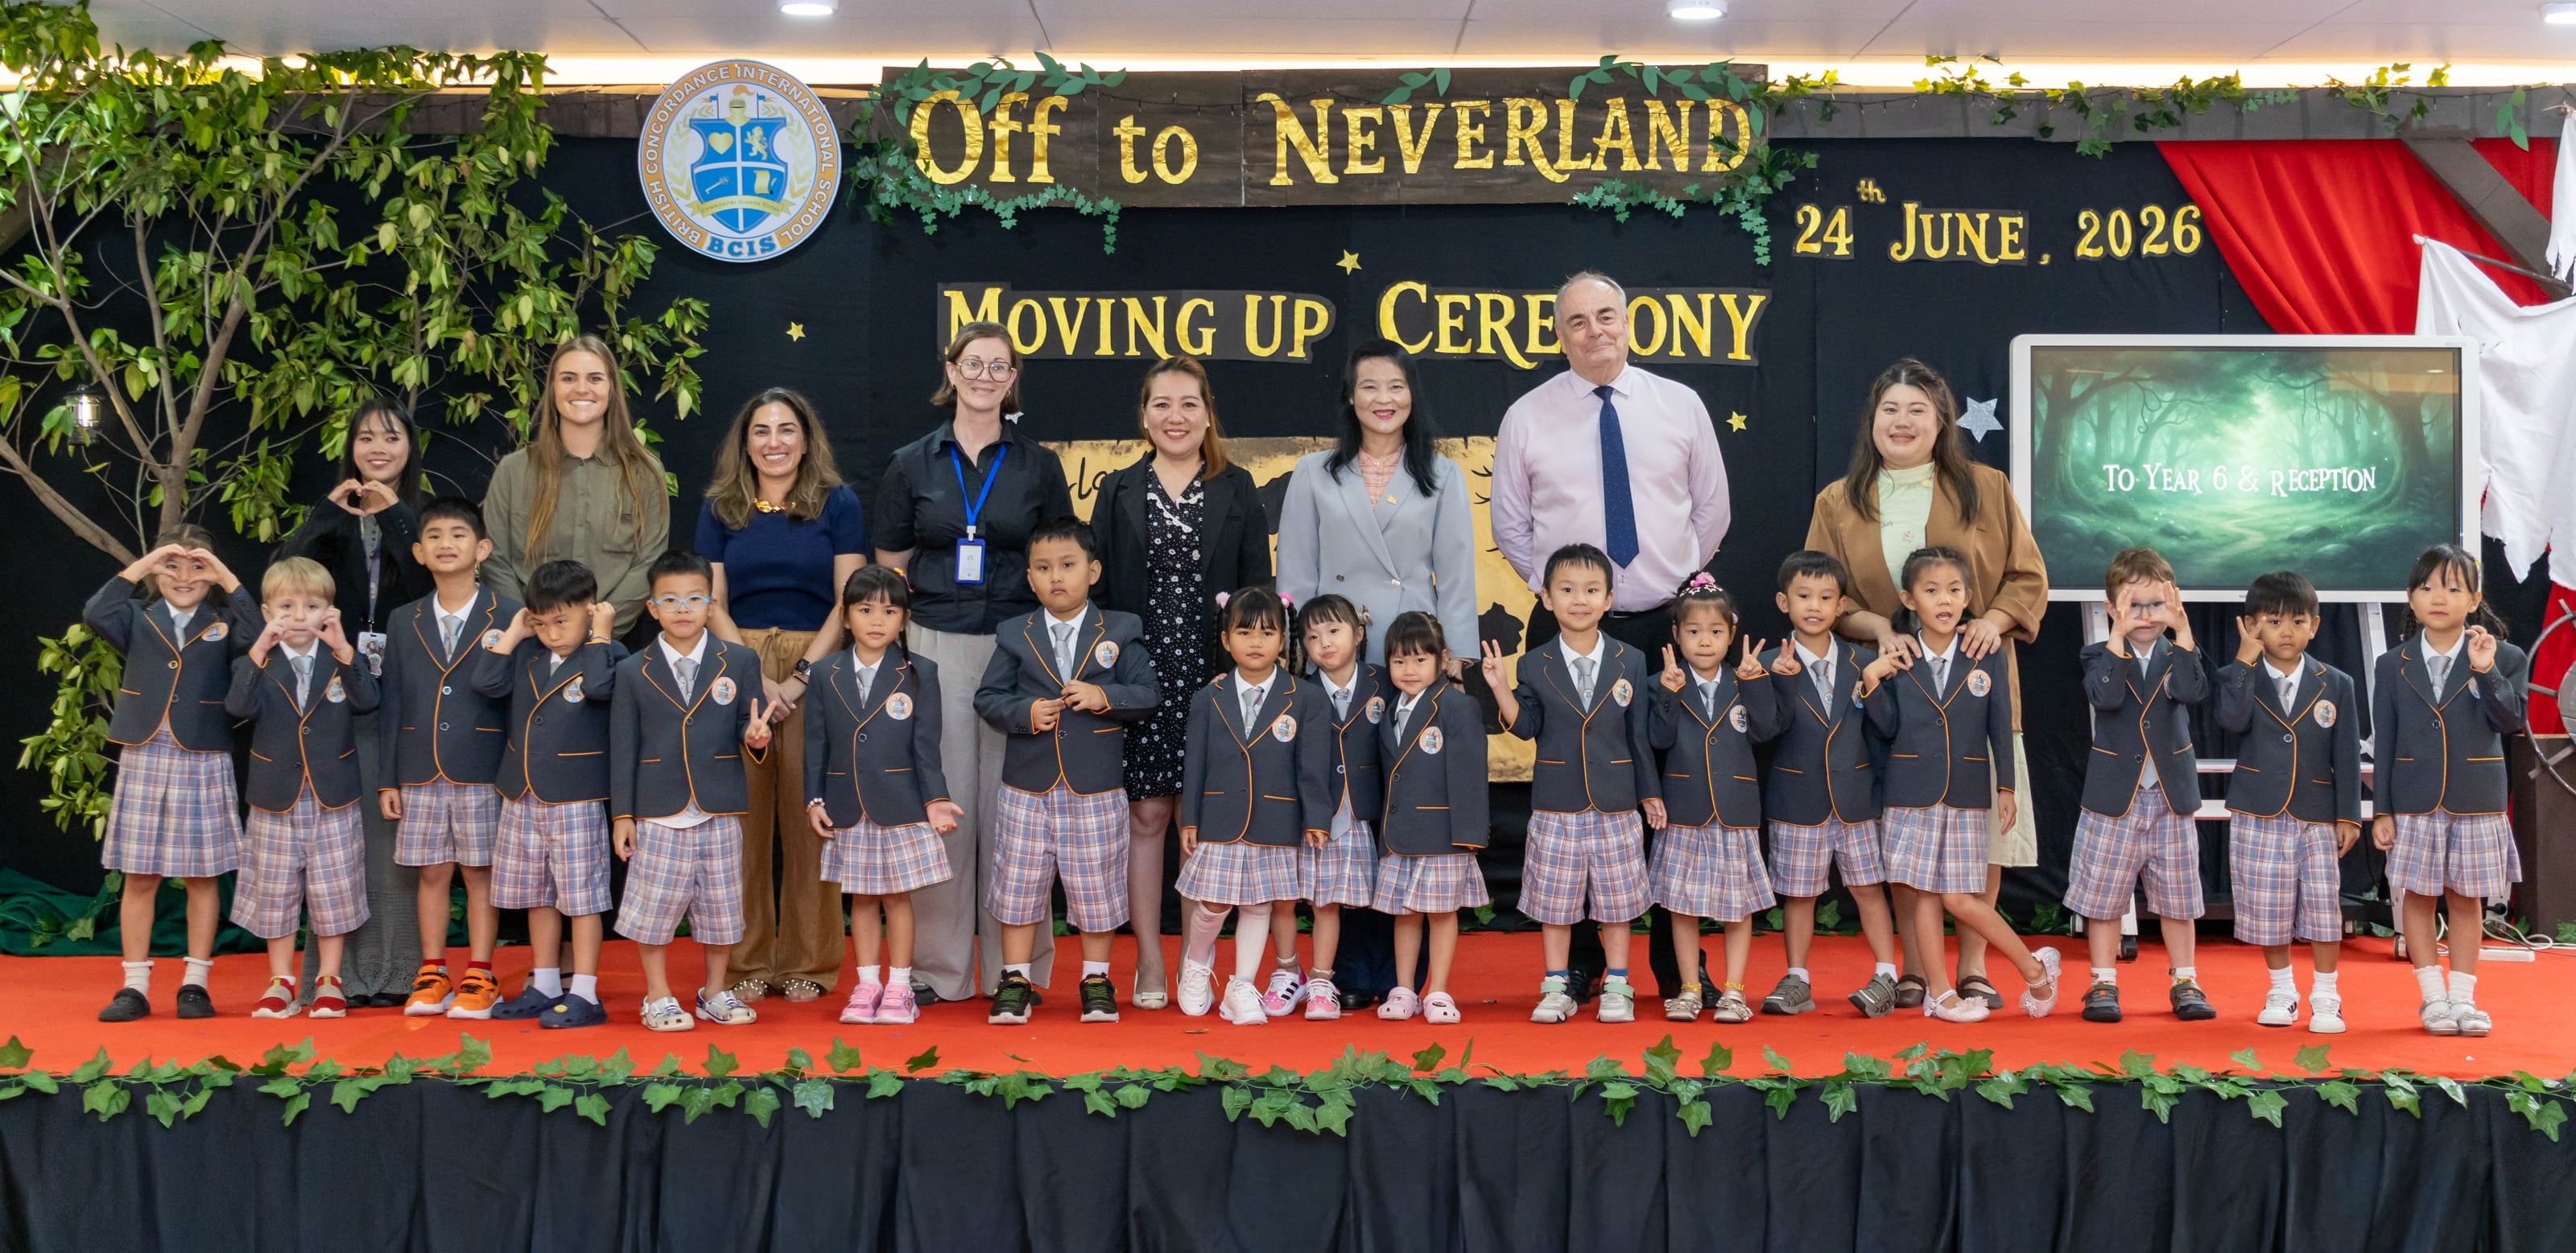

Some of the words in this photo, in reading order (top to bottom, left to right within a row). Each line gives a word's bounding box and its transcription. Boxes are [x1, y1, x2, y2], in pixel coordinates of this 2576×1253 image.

[646, 66, 730, 175] CONCORDANCE
[736, 64, 834, 173] INTERNATIONAL
[910, 89, 1067, 184] Off
[1113, 115, 1198, 184] to
[1256, 93, 1751, 185] NEVERLAND
[649, 179, 702, 245] BRITISH
[780, 179, 832, 242] SCHOOL
[2076, 204, 2202, 258] 2026
[708, 236, 776, 257] BCIS
[943, 287, 1216, 359] MOVING
[1245, 295, 1329, 358] UP
[1379, 281, 1767, 370] CEREONY
[2214, 465, 2227, 491] 6
[2238, 465, 2260, 492] &
